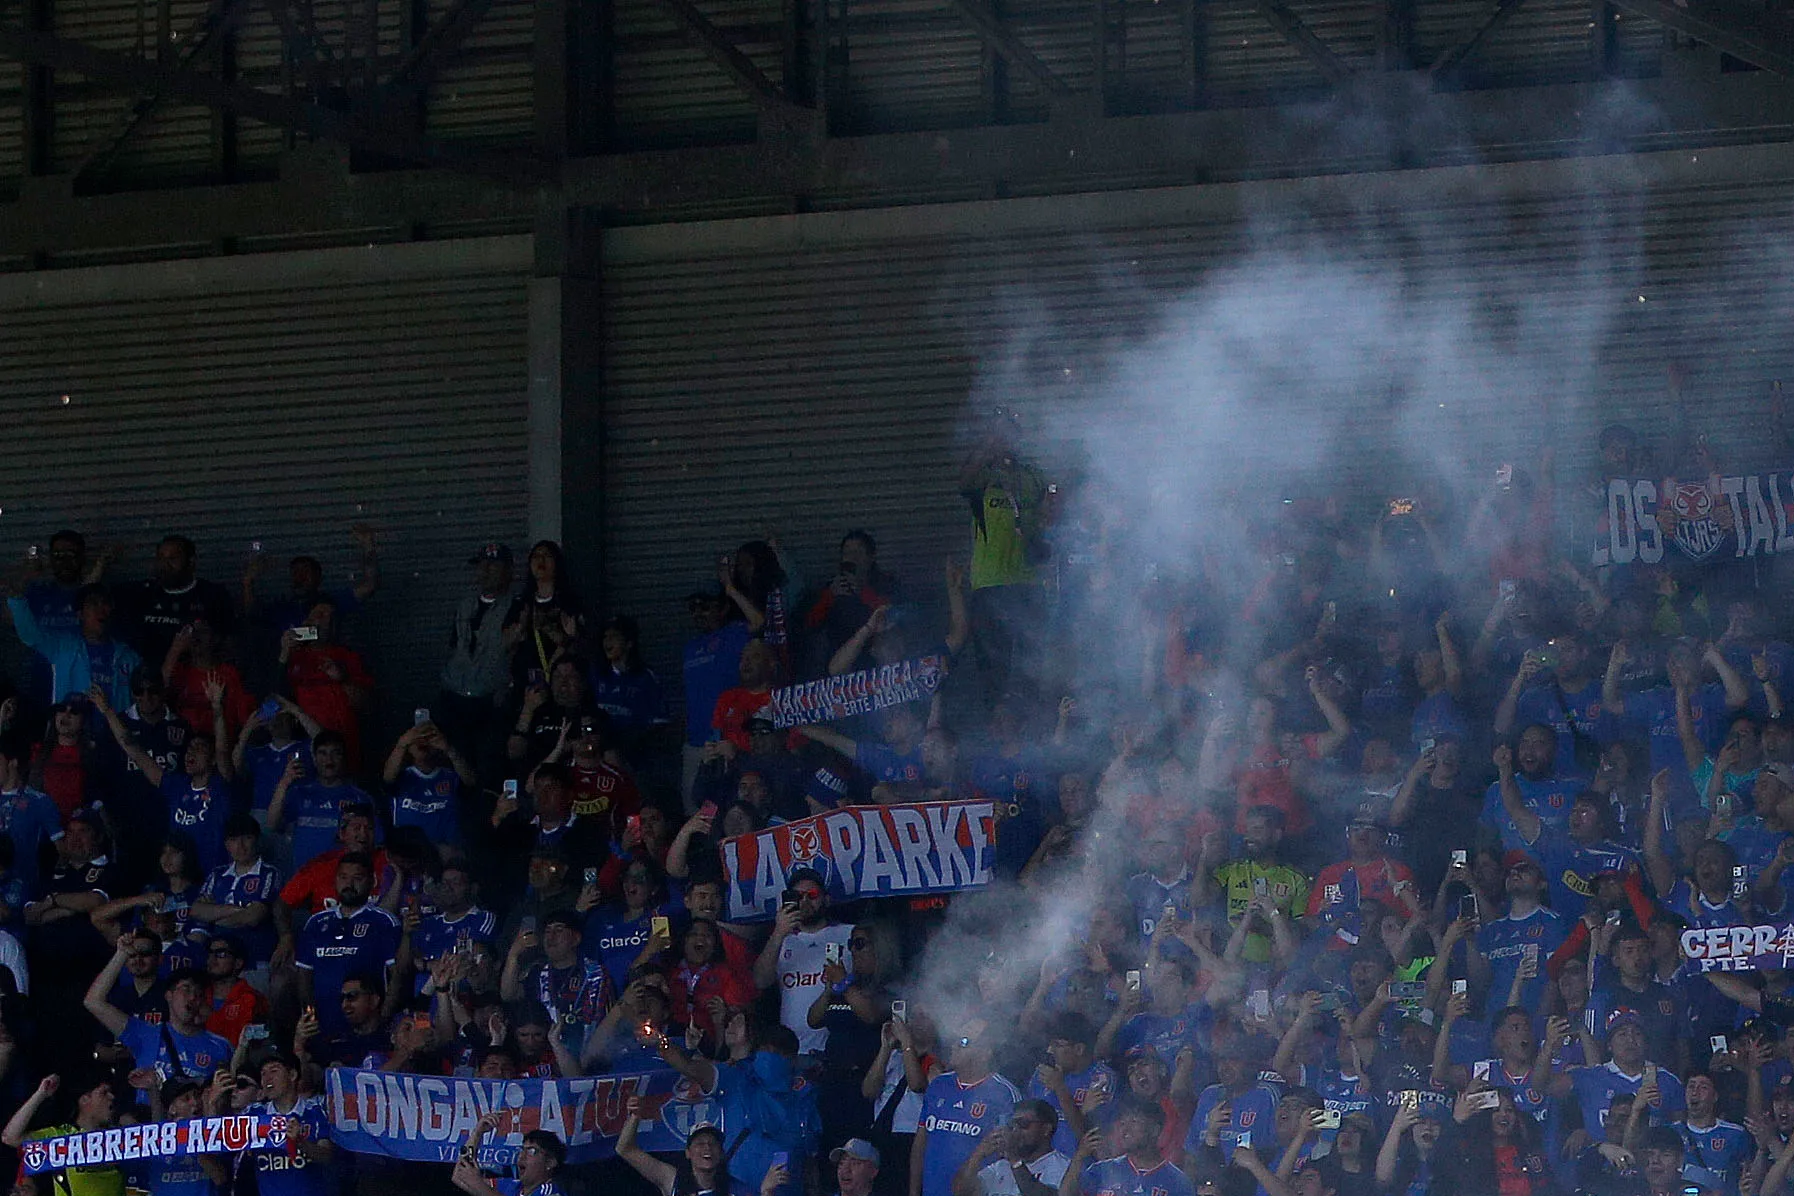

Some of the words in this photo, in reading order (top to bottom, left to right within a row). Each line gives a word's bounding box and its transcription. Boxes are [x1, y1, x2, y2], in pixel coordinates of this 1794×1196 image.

[824, 696, 871, 723] MERTE
[725, 833, 787, 918] LA
[824, 802, 994, 895] PARKE
[331, 1067, 525, 1147] LONGAV
[540, 1073, 654, 1147] AZUL
[186, 1115, 266, 1152] AZUL
[937, 1117, 981, 1137] BETANO
[257, 1151, 312, 1172] Claro
